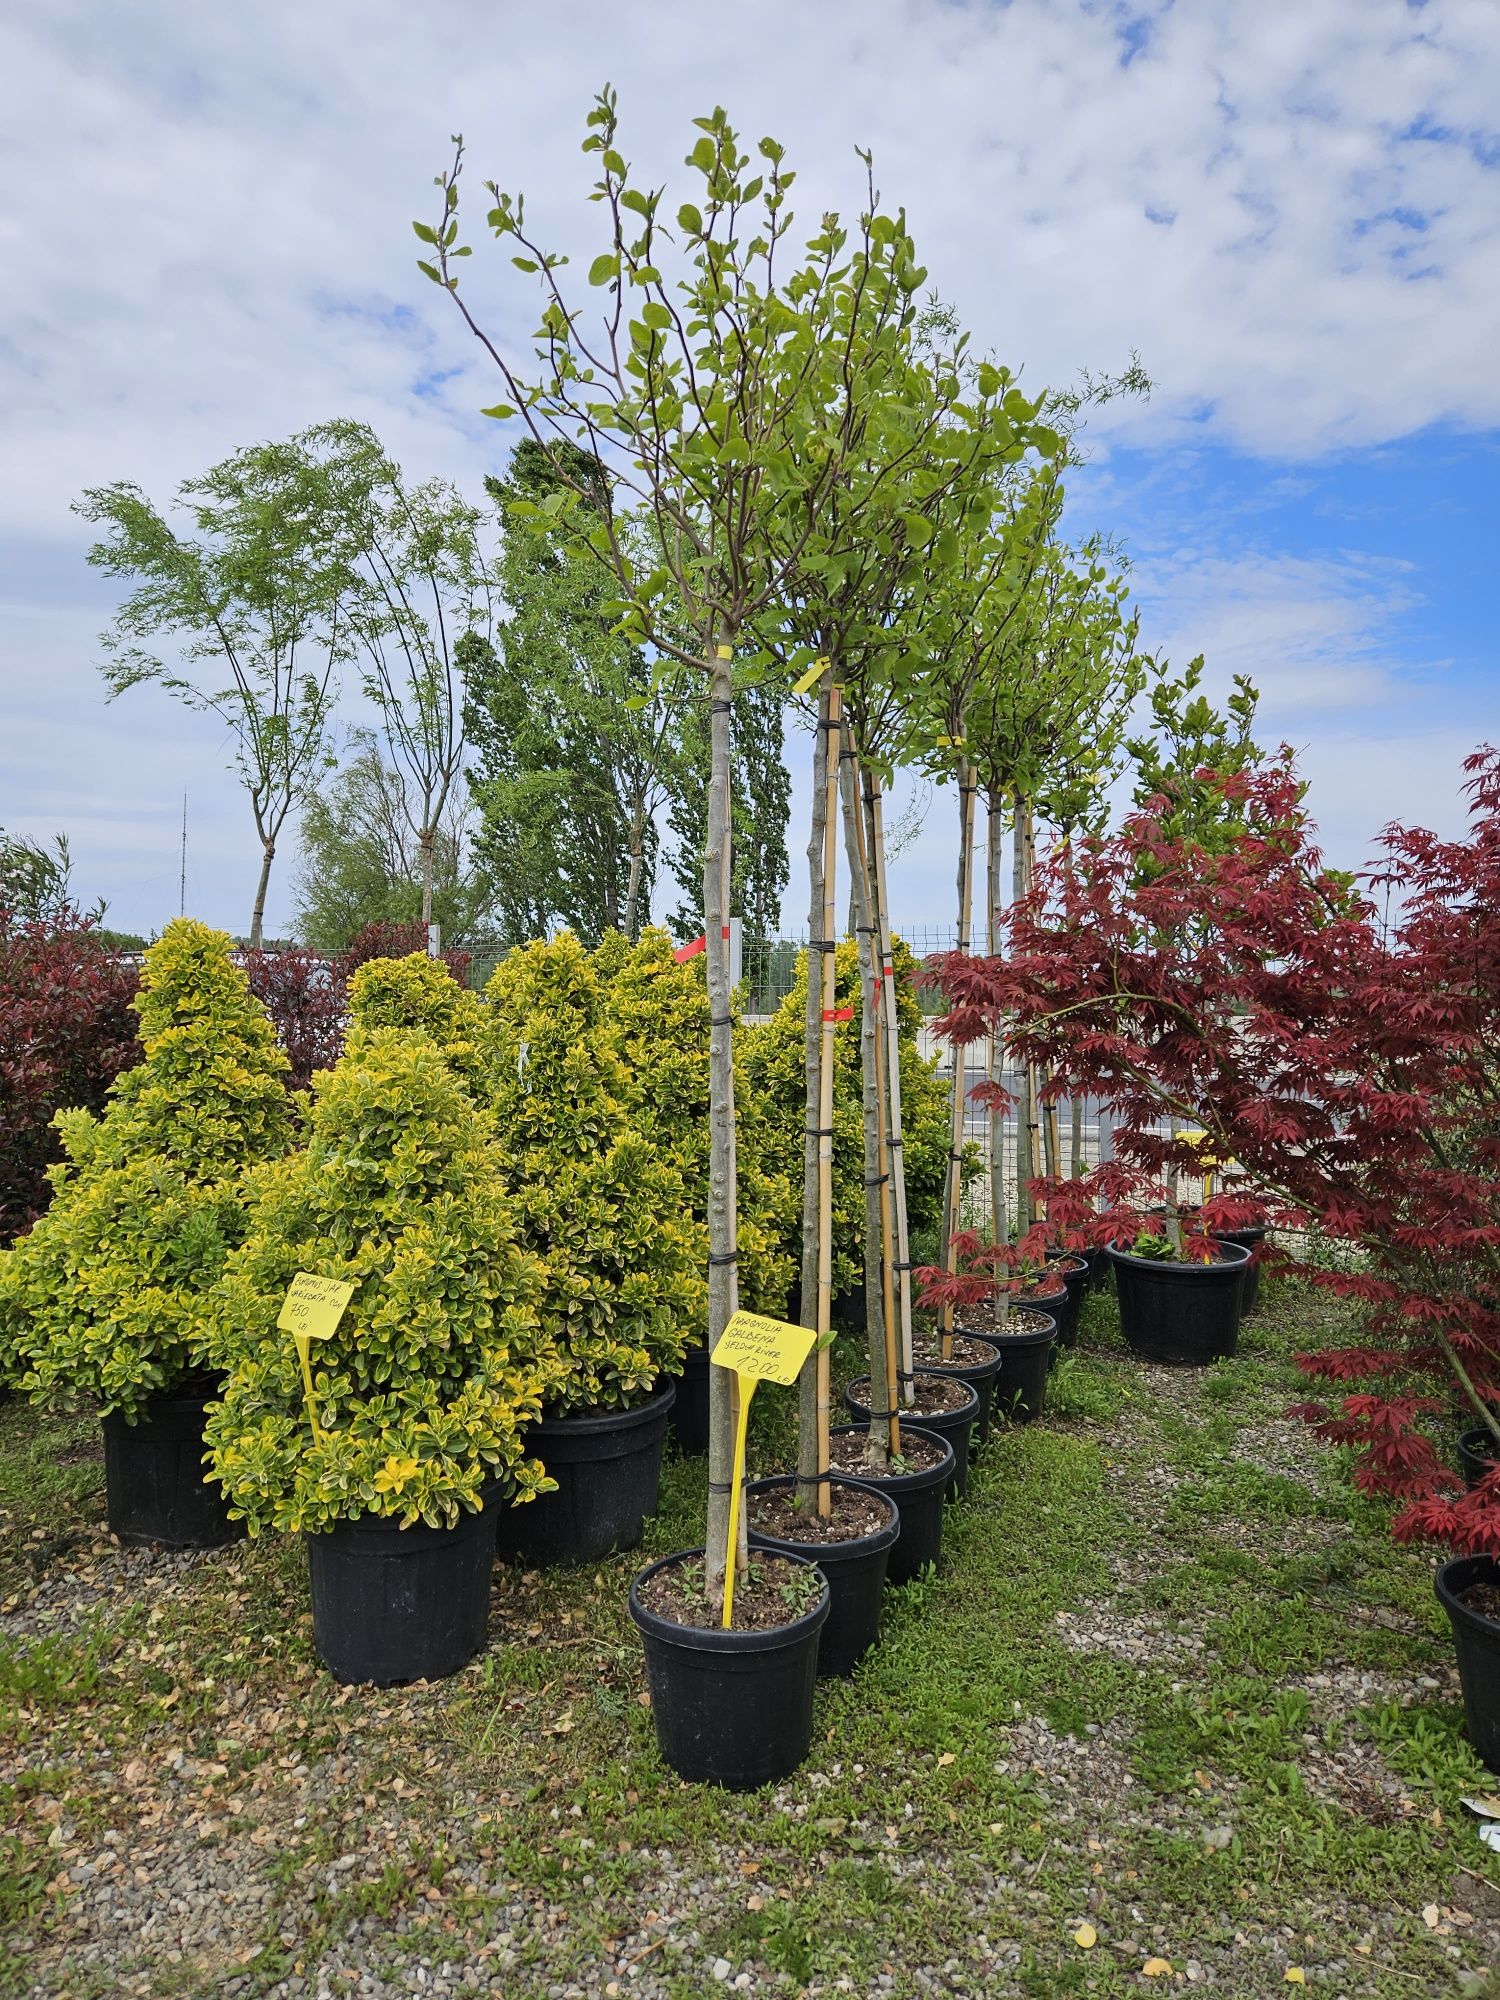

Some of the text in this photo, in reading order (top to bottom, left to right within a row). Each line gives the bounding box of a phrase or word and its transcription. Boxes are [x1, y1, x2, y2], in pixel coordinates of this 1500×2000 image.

[290, 1302, 309, 1317] 750
[732, 1317, 782, 1333] MAGNOLIA
[728, 1328, 776, 1343] GALBENA
[755, 1345, 781, 1359] RIVER
[737, 1356, 779, 1375] 1200
